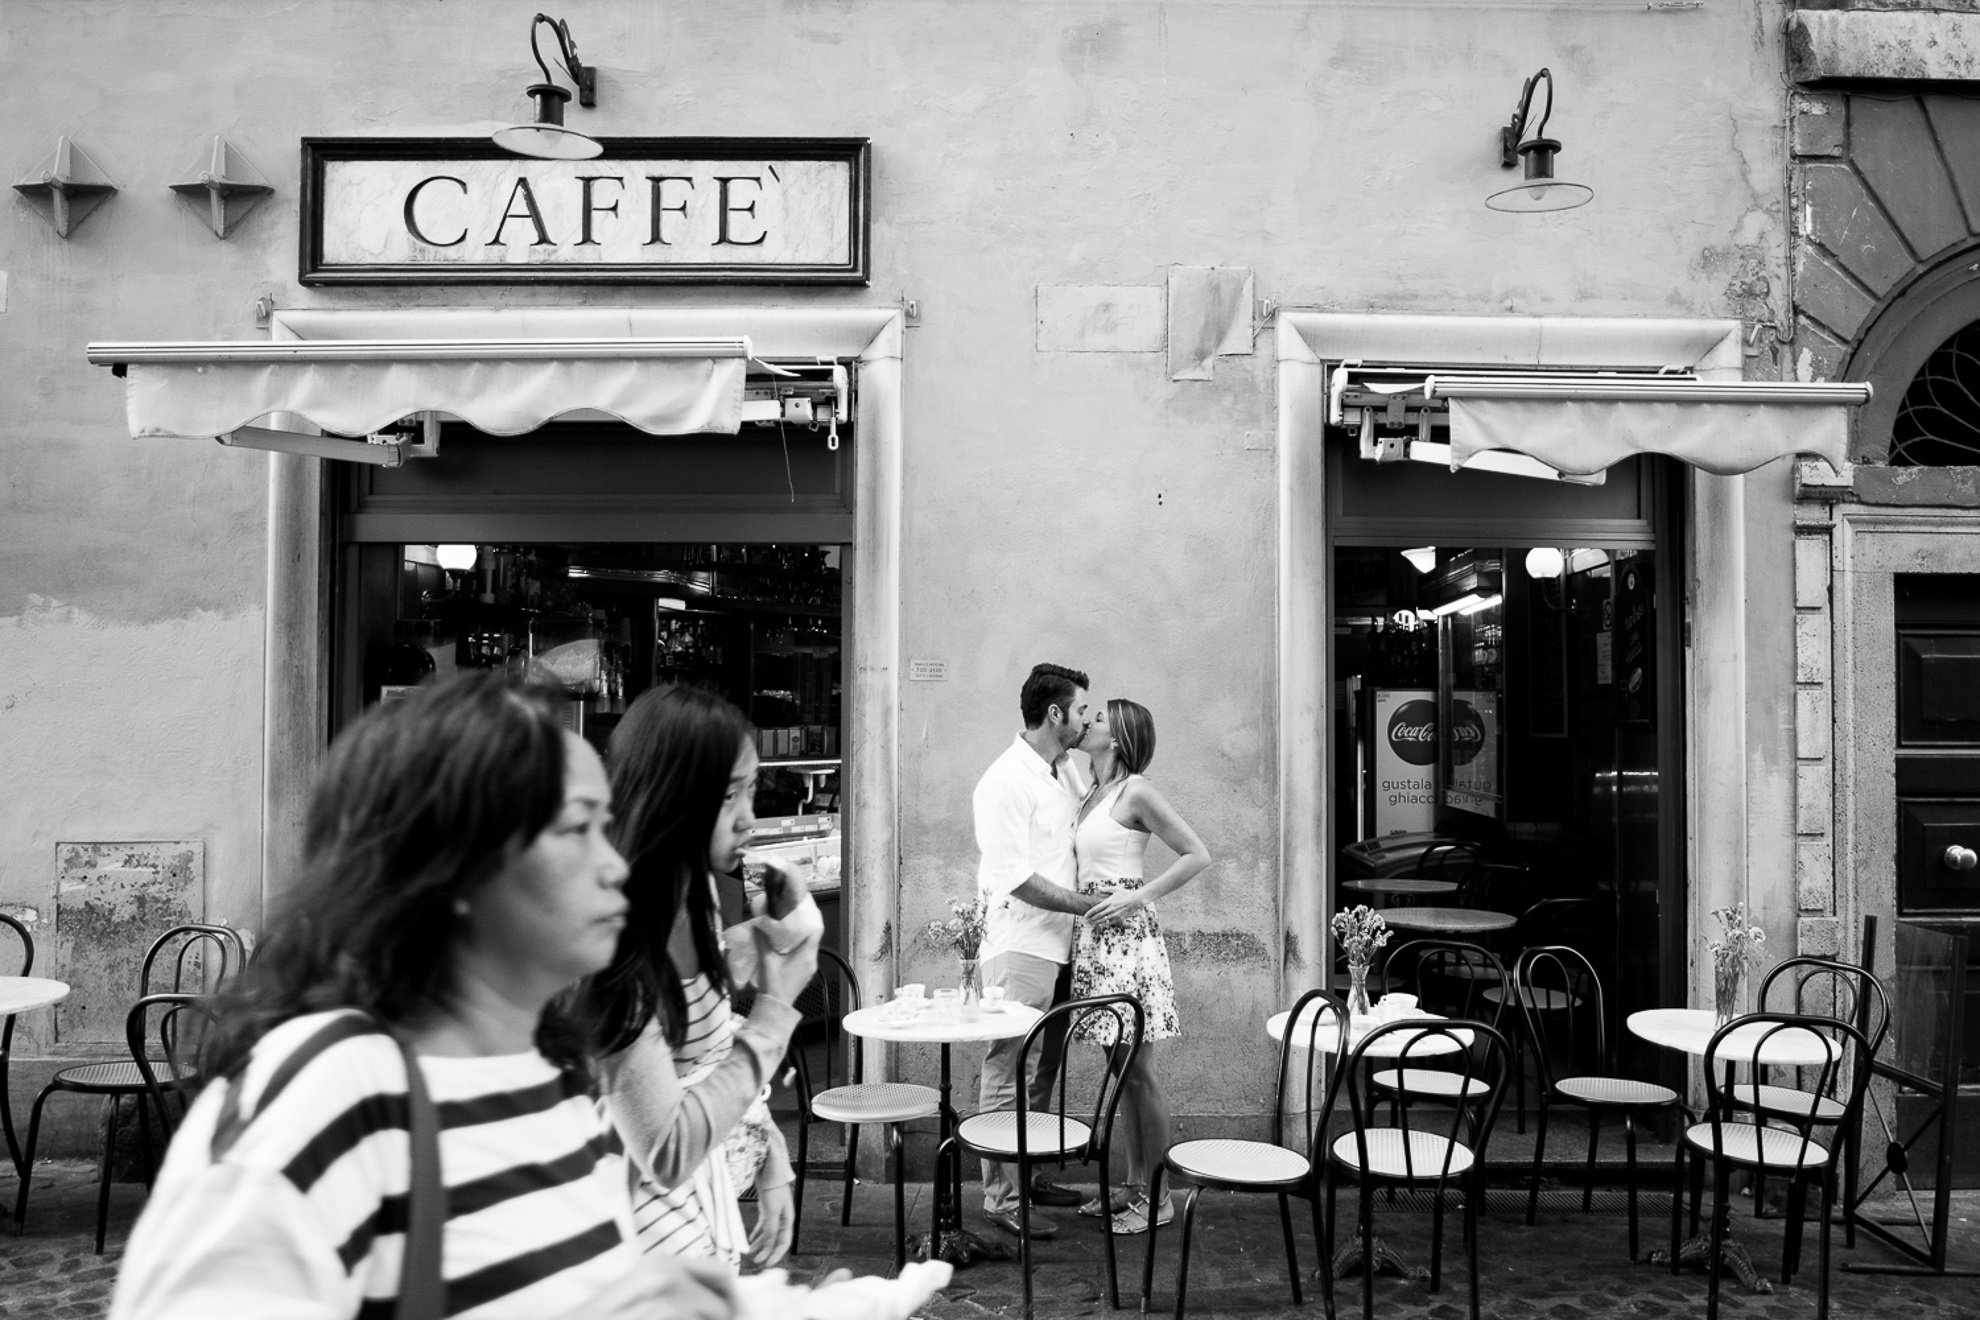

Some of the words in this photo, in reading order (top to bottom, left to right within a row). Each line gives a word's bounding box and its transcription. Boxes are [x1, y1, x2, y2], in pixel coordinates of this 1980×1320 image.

[1391, 721, 1436, 742] Coca-Co
[1382, 778, 1432, 791] gustala
[1388, 792, 1434, 806] ghiacc
